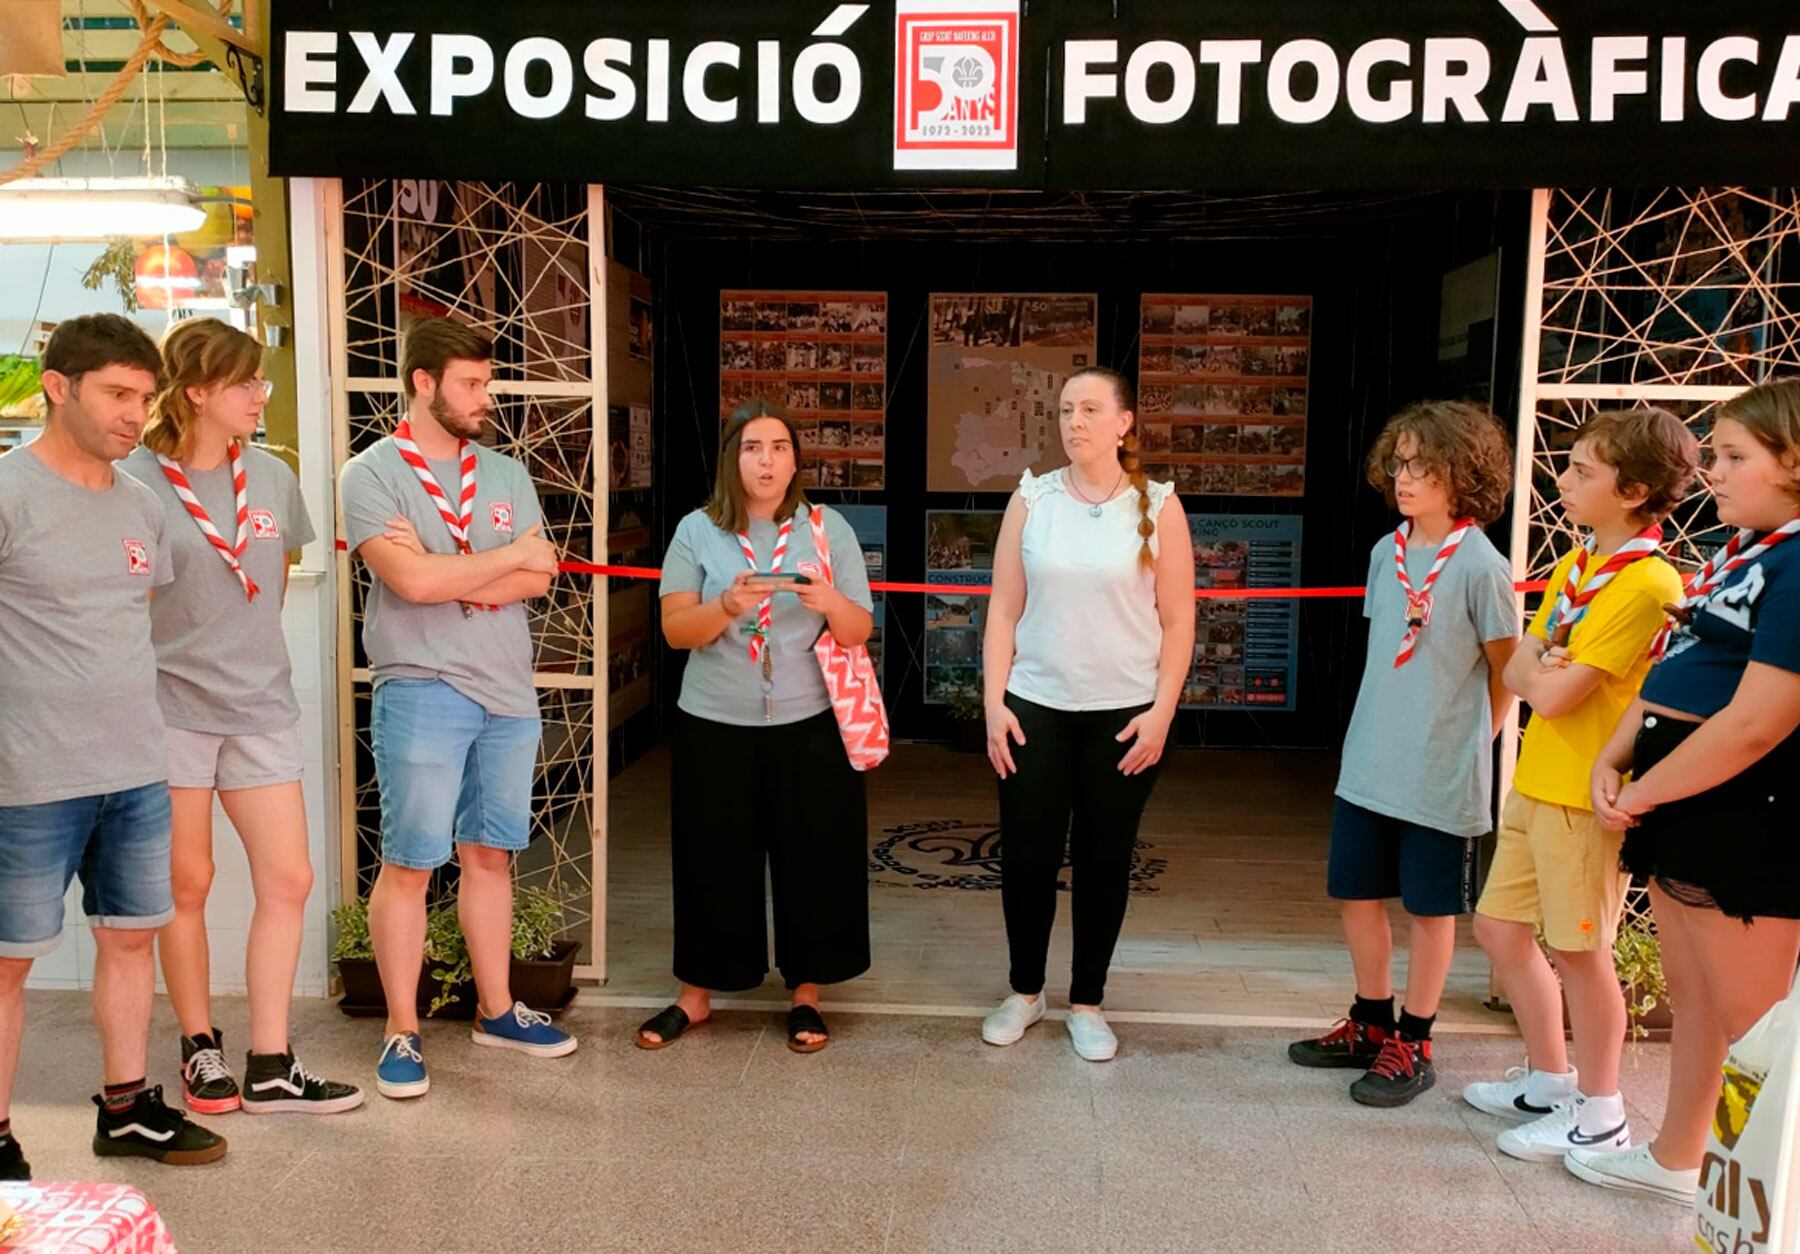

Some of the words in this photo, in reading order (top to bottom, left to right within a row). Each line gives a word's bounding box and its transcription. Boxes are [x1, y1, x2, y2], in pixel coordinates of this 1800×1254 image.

[284, 4, 870, 124] EXPOSICIÓ
[922, 125, 951, 136] 1972
[961, 125, 991, 136] 2022
[1241, 519, 1280, 529] SCOUT
